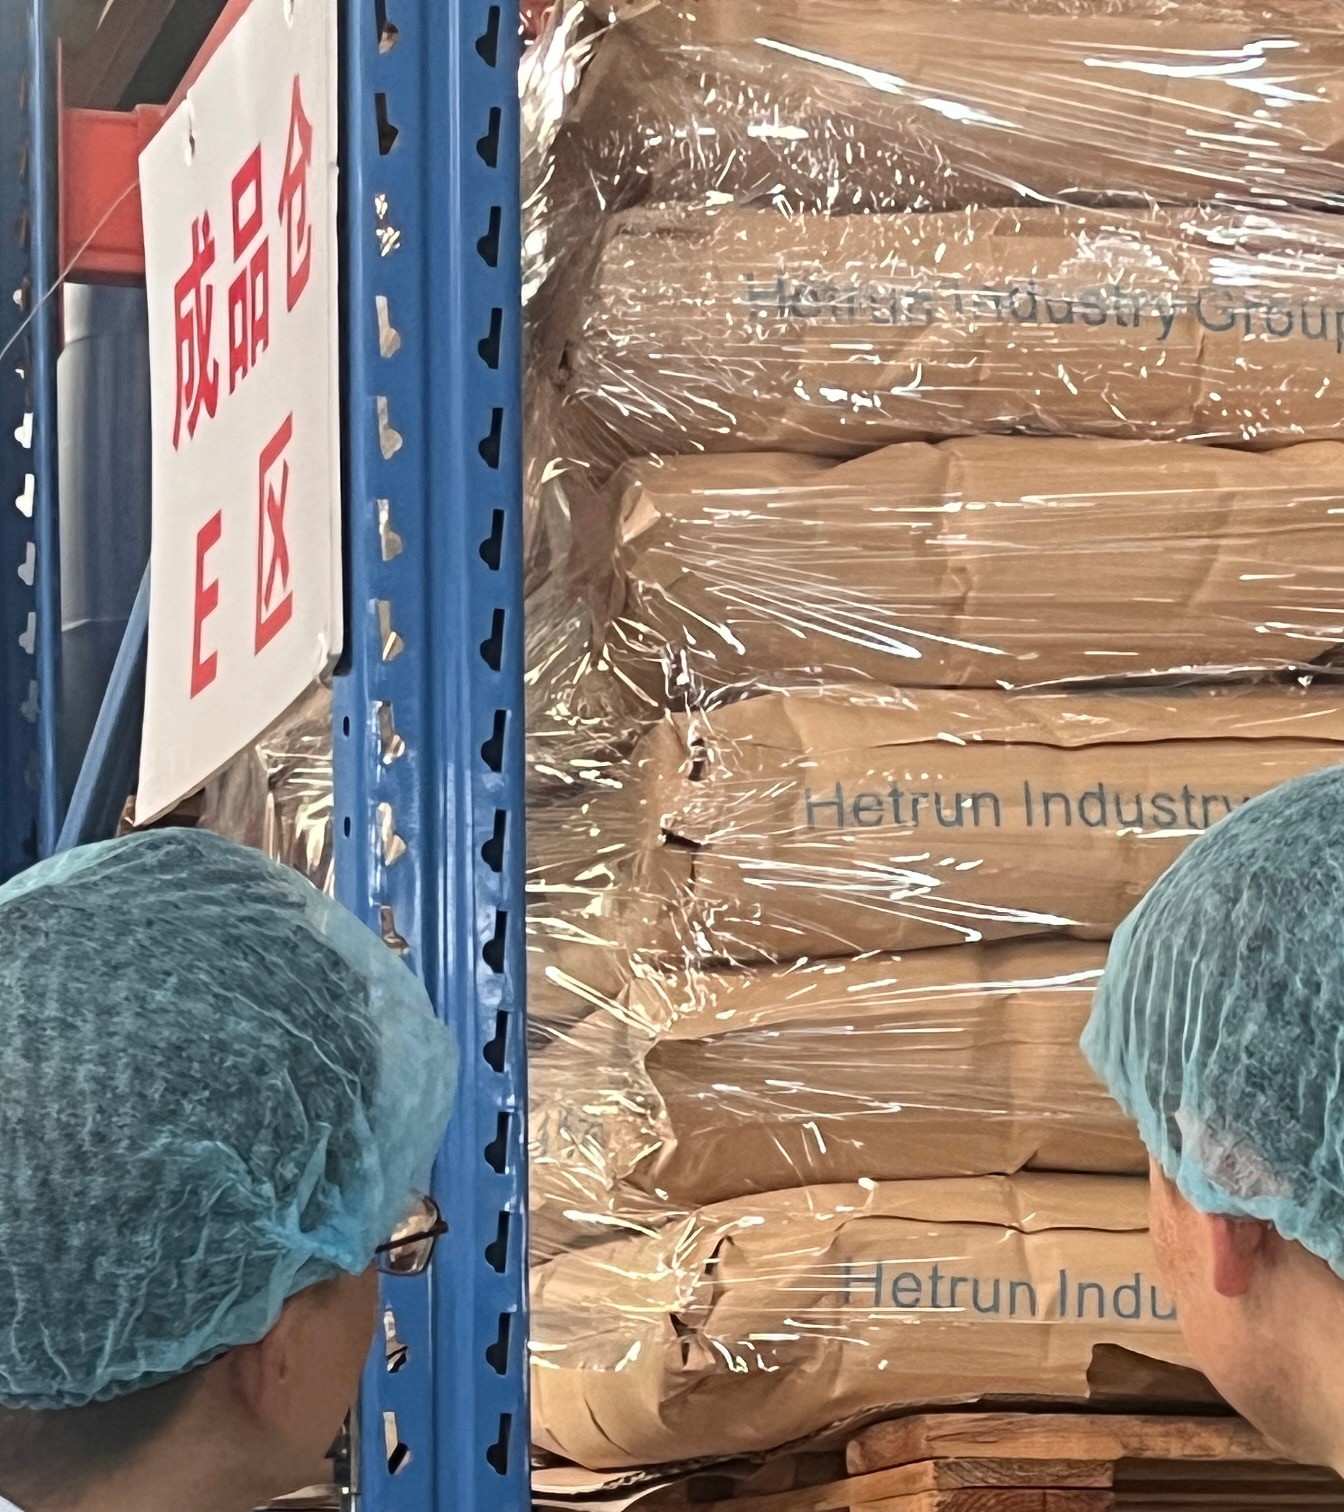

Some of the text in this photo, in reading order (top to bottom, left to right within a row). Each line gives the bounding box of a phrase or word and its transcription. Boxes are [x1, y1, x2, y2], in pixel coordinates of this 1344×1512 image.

[172, 74, 313, 451] 成品仓
[804, 779, 1002, 829] Hetrun
[843, 1256, 1038, 1318] Hetrun
